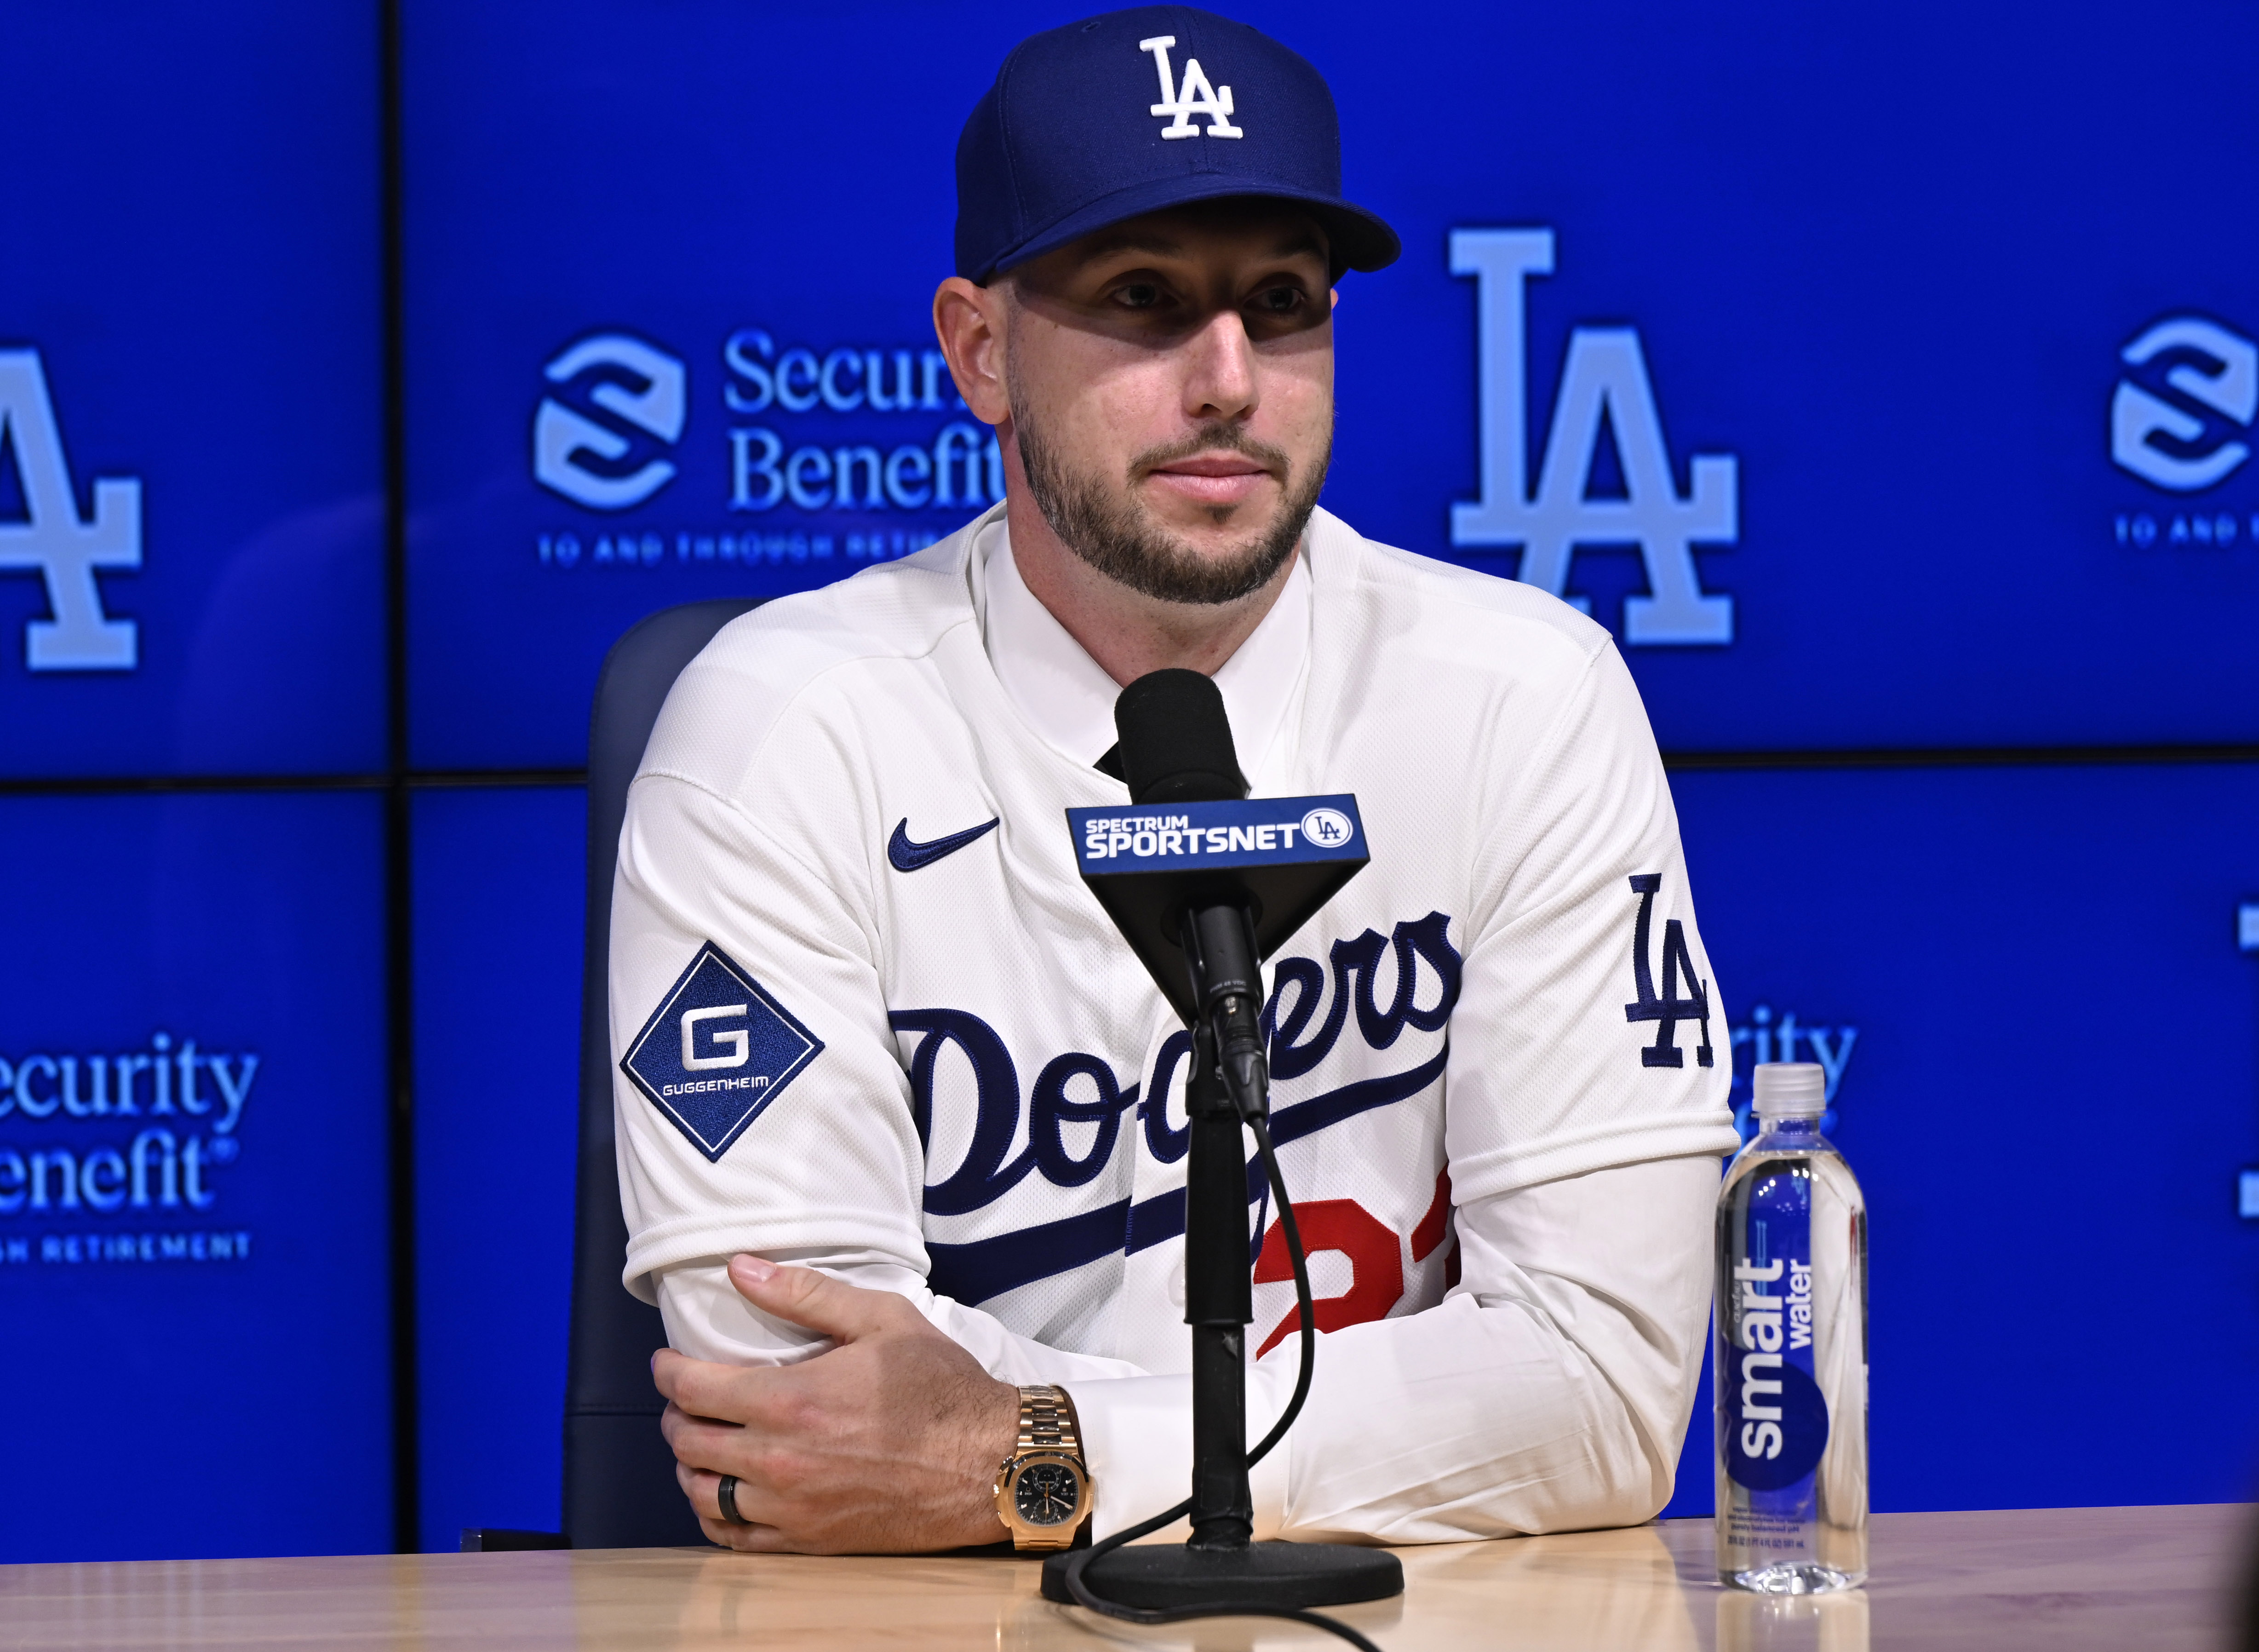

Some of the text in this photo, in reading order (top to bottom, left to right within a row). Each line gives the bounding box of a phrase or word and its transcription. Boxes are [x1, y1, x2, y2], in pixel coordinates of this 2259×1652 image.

[1139, 35, 1243, 140] LA
[724, 329, 968, 413] Secur
[1448, 228, 1738, 644] LA
[1085, 815, 1188, 834] SPECTRUM
[1086, 823, 1301, 859] SPORTSNET
[1314, 815, 1341, 840] LA
[1625, 873, 1714, 1069] LA
[681, 1004, 750, 1072] G
[663, 1076, 769, 1096] GUGGENHEIM
[41, 1231, 249, 1263] RETIREMENT
[1784, 1258, 1812, 1350] water
[1733, 1258, 1784, 1461] smart
